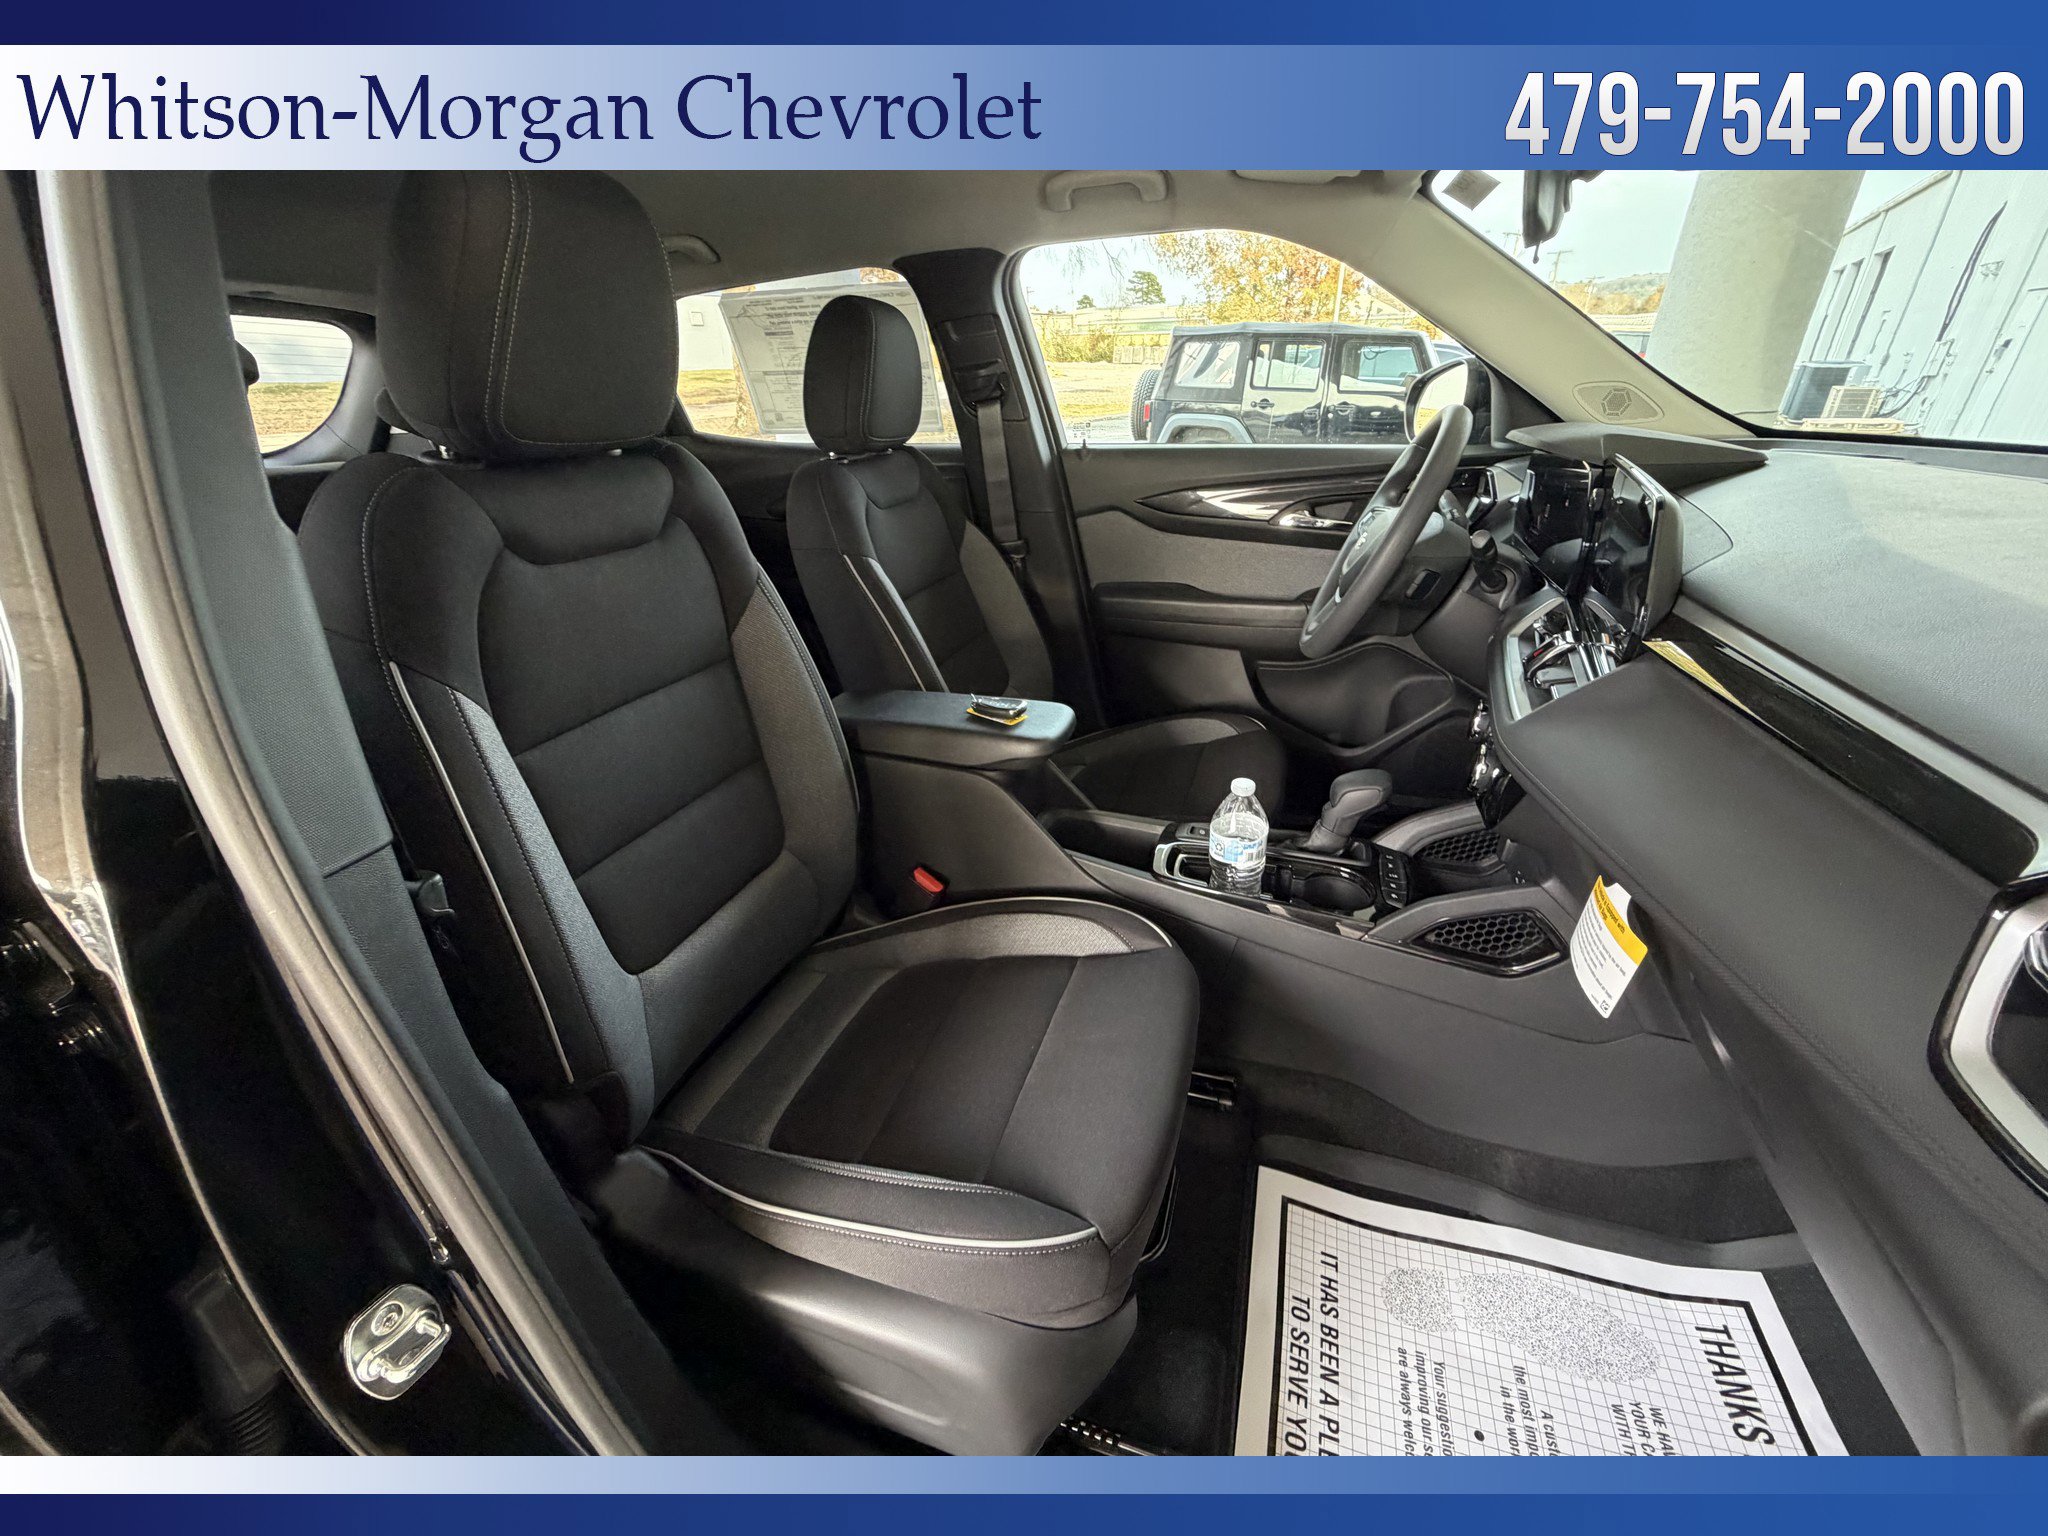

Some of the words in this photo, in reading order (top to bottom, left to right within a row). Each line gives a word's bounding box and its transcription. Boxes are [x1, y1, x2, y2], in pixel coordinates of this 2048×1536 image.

[1320, 1251, 1339, 1273] IT
[1292, 1295, 1310, 1323] TO
[1320, 1275, 1339, 1319] HAS
[1288, 1327, 1310, 1409] SERVE
[1320, 1323, 1340, 1386] BEEN
[1397, 1347, 1408, 1368] are
[1413, 1350, 1431, 1415] improving
[1433, 1361, 1446, 1389] Your
[1513, 1365, 1527, 1385] the
[1695, 1324, 1776, 1445] THANKS
[1319, 1388, 1340, 1407] A
[1399, 1370, 1413, 1416] always
[1500, 1386, 1512, 1398] in
[1518, 1388, 1536, 1422] most
[1503, 1402, 1517, 1424] the
[1540, 1410, 1554, 1420] A
[1611, 1404, 1632, 1439] WITH
[1629, 1402, 1651, 1439] YOUR
[1649, 1408, 1668, 1429] WE
[1421, 1418, 1433, 1442] our
